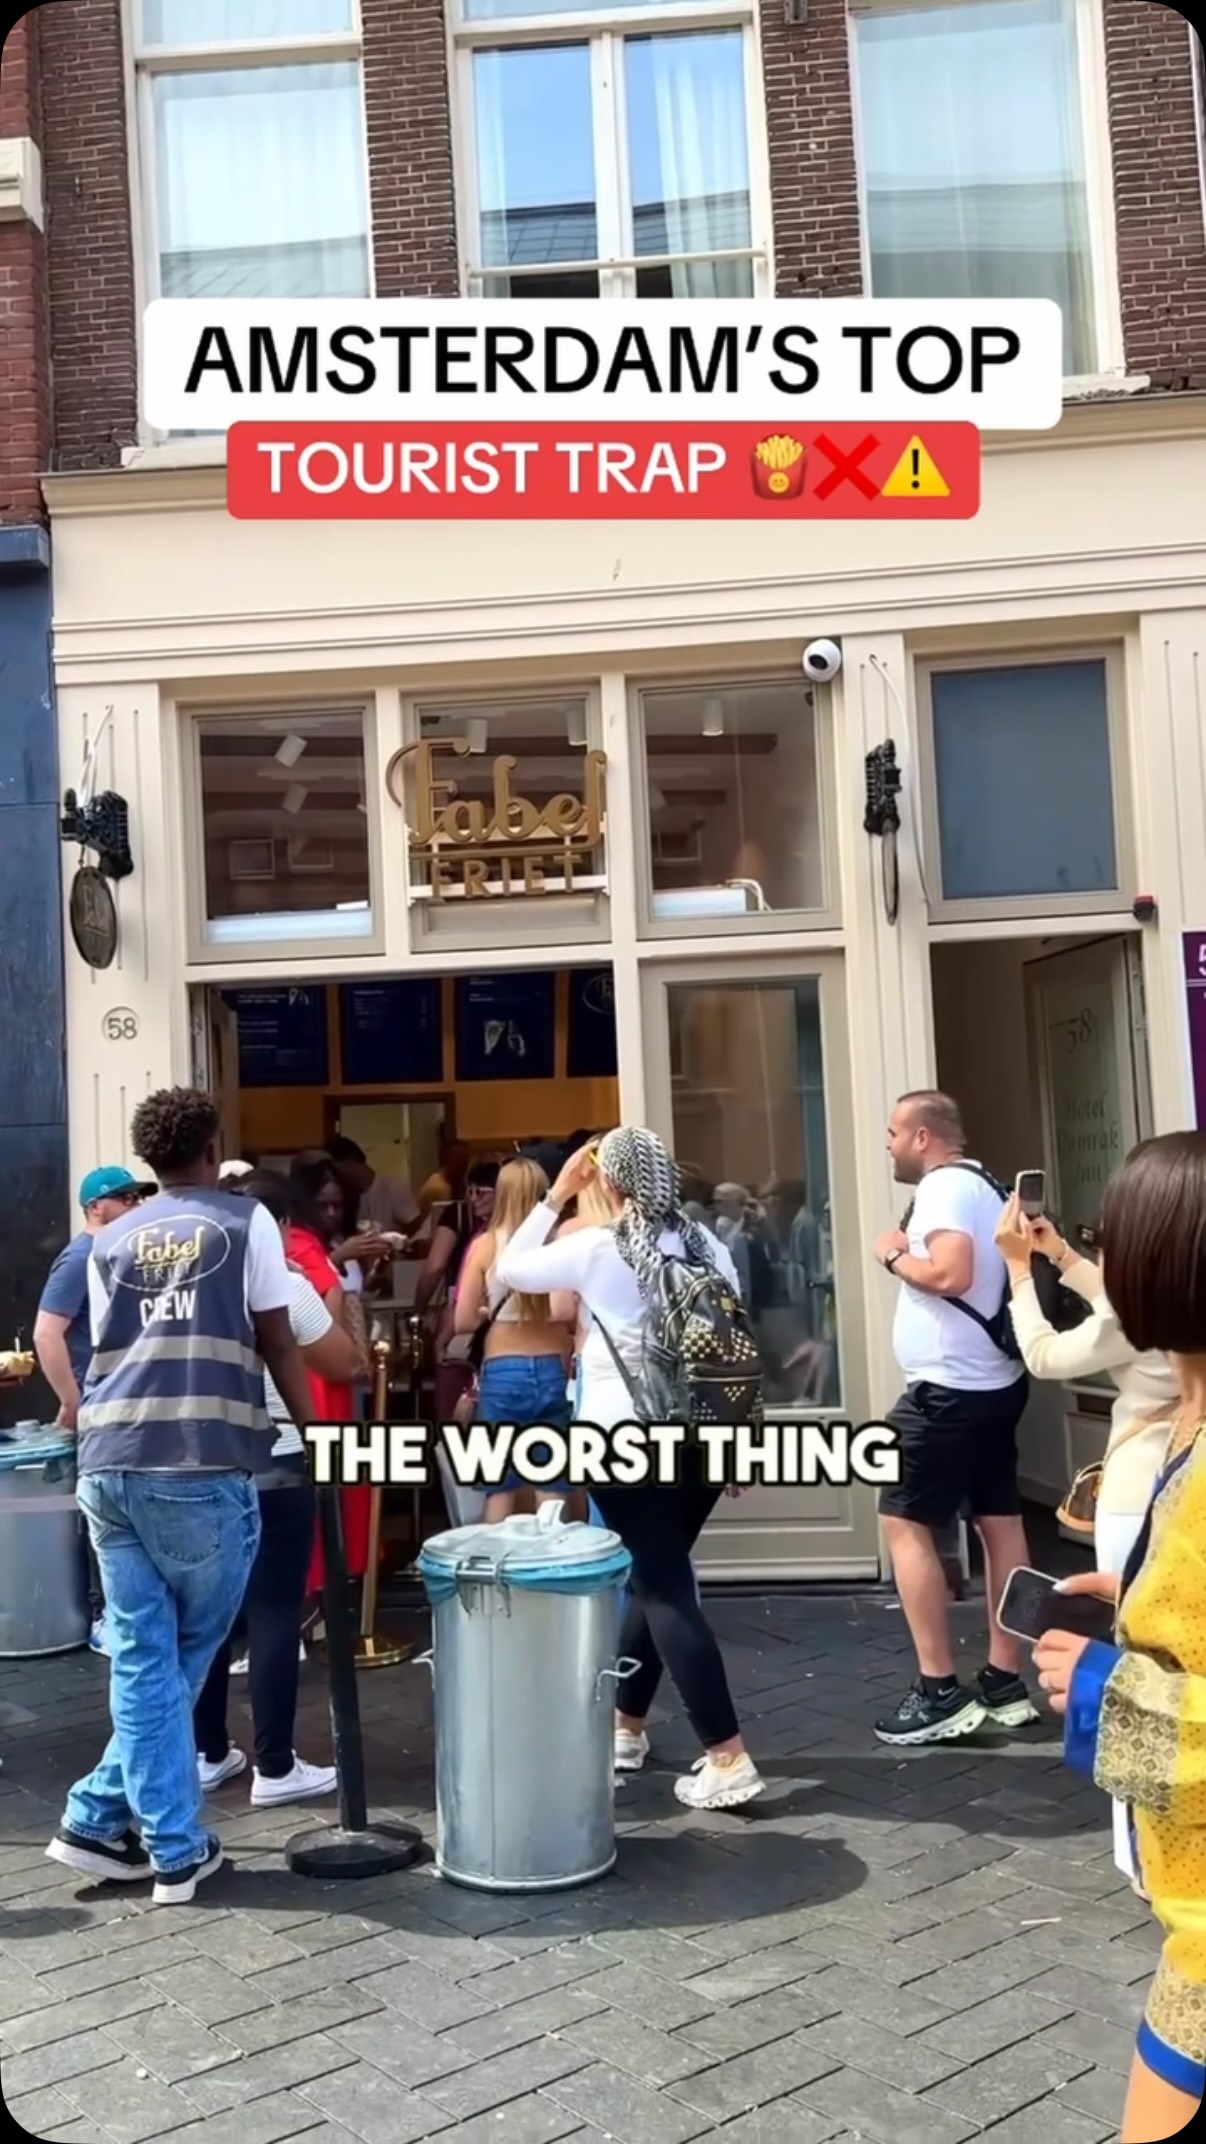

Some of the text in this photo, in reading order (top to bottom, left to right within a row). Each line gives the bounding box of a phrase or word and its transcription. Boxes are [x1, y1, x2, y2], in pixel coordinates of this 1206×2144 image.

[385, 736, 608, 850] Fabel
[427, 852, 583, 905] FRIET
[107, 1017, 138, 1041] 58
[127, 1226, 206, 1266] Fabel
